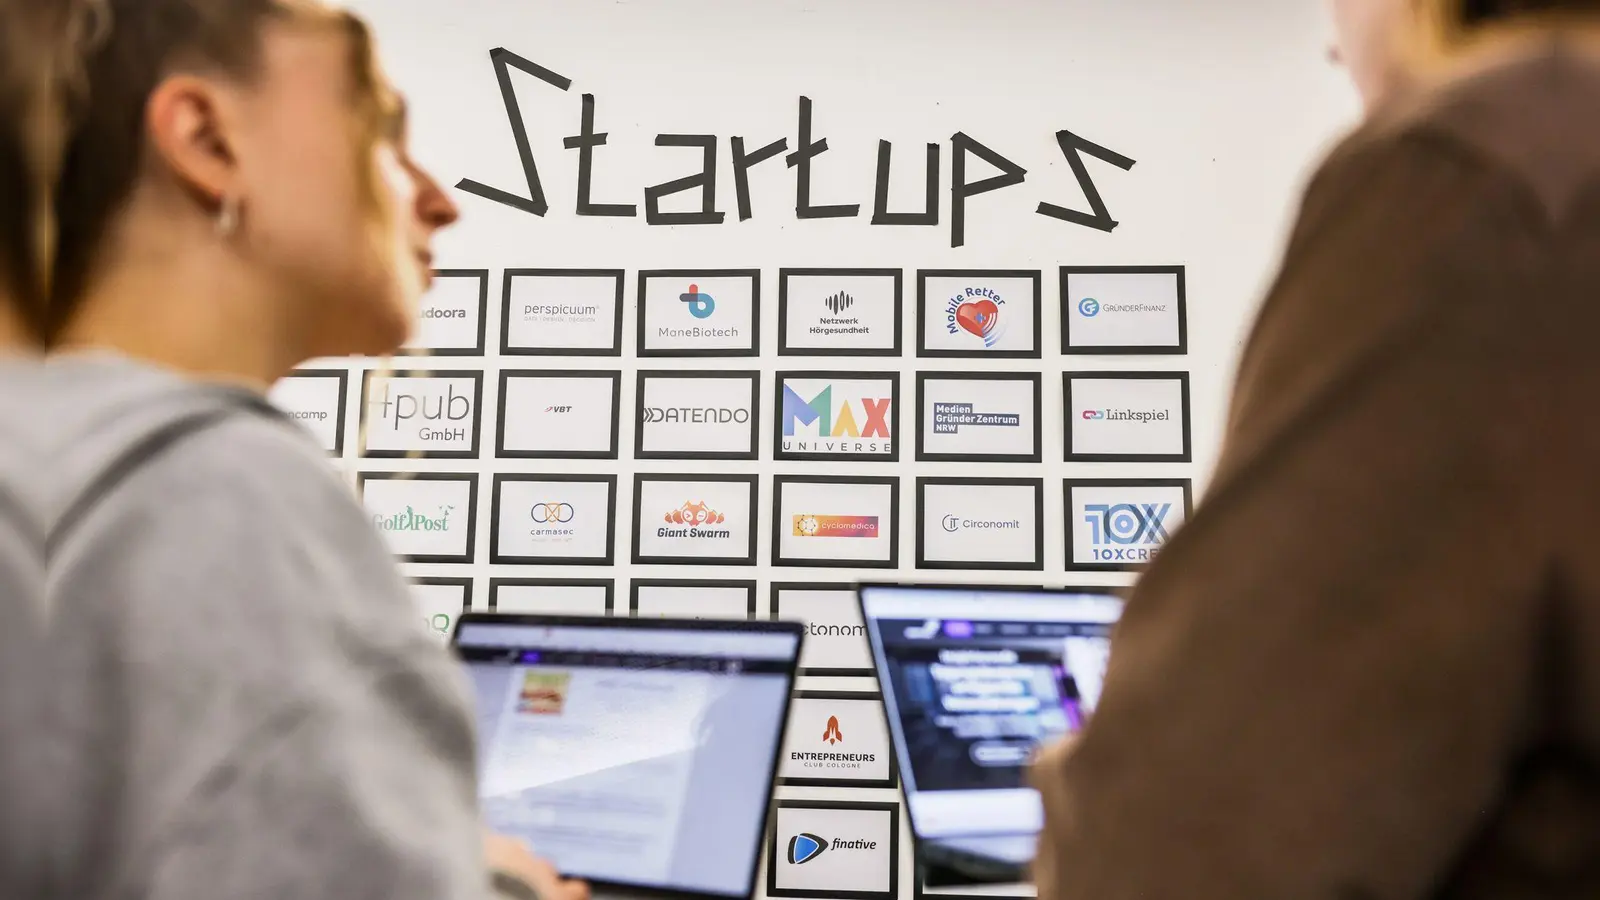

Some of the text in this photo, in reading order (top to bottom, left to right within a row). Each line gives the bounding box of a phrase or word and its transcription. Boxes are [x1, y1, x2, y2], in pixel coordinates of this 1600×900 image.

[455, 47, 1137, 248] Startups
[524, 304, 596, 315] perspicuum
[945, 287, 1006, 334] Mobile Retter
[820, 317, 859, 325] Netzwerk
[658, 327, 739, 337] ManeBiotech
[809, 327, 869, 336] Hörgesundheit
[936, 404, 971, 413] Medien
[651, 407, 749, 423] DATENDO
[935, 414, 1018, 424] Gründer Zentrum
[1106, 409, 1169, 424] Linkspiel
[936, 424, 956, 432] NRW
[418, 427, 465, 441] GmbH
[783, 441, 891, 452] UNIVERSE
[821, 522, 875, 530] cyclomedica
[962, 519, 1020, 529] Circonomit
[657, 527, 730, 538] Giant Swarm
[1092, 548, 1161, 560] 10XCRE
[803, 622, 867, 636] tonom
[791, 752, 875, 762] ENTREPRENEURS
[831, 837, 877, 851] finative
